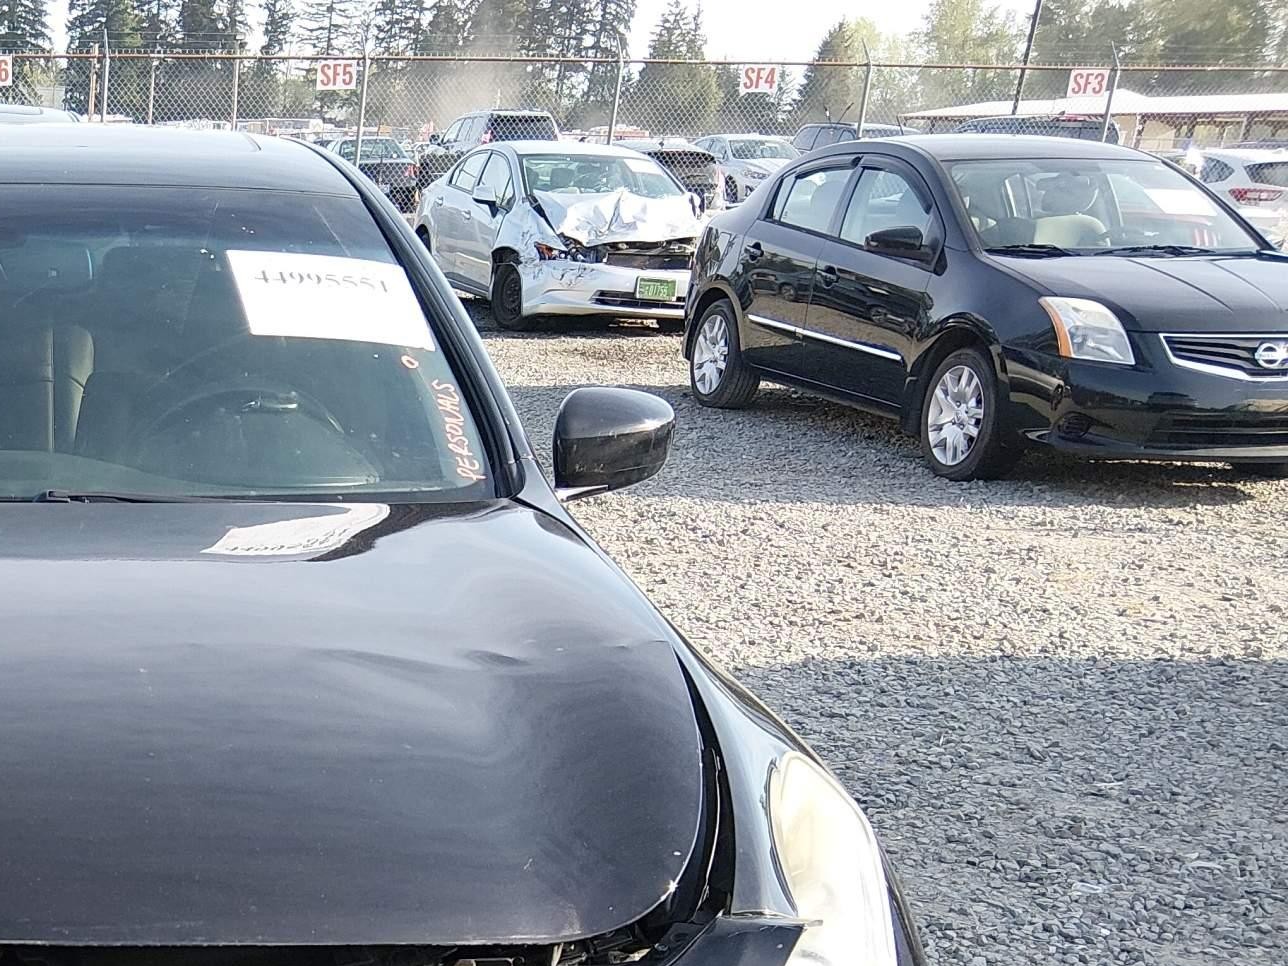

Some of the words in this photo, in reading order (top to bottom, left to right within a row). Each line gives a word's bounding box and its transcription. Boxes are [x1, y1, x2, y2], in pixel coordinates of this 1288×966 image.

[320, 63, 354, 86] SF5
[743, 67, 776, 89] SF4
[1072, 72, 1105, 94] SF3
[431, 378, 488, 482] PERSONALS
